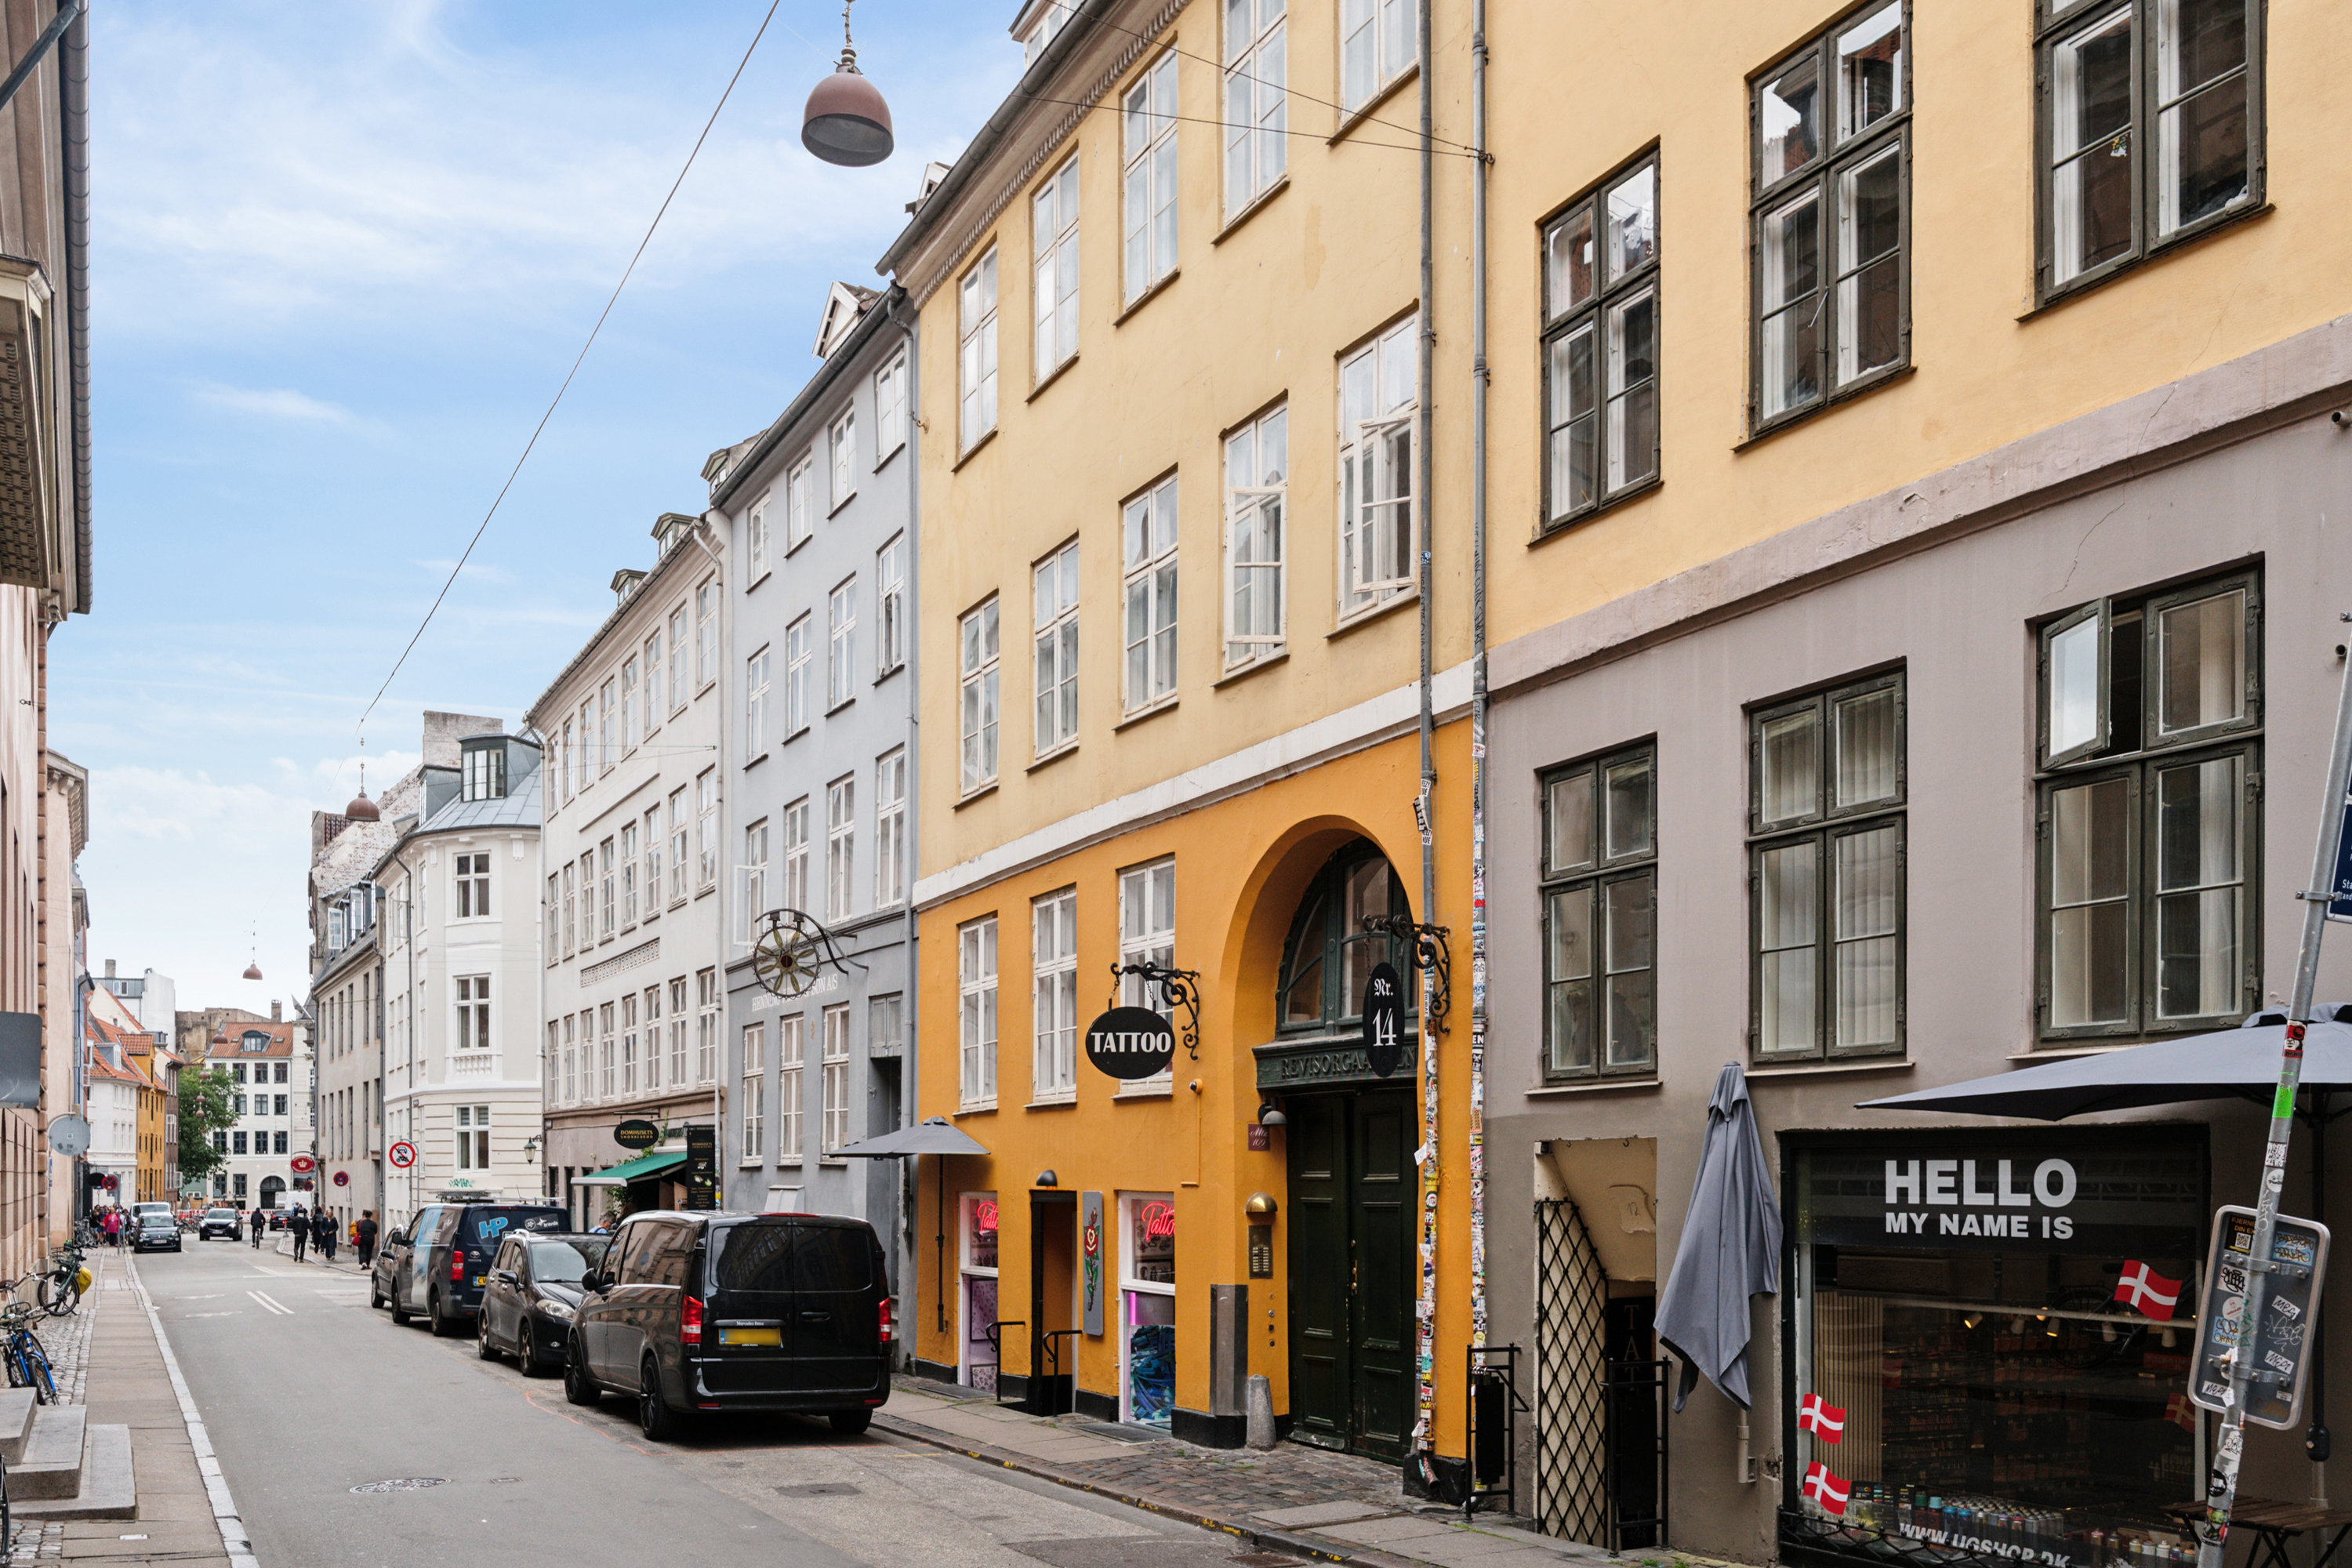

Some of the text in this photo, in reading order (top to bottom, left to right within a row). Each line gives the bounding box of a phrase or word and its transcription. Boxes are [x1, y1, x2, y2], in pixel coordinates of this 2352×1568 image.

[1374, 978, 1394, 996] Nr.
[1372, 1008, 1397, 1047] 14
[1091, 1032, 1171, 1053] TATTOO
[1885, 1158, 2077, 1208] HELLO
[478, 1216, 509, 1240] HP
[1886, 1212, 2074, 1240] MY NAME IS
